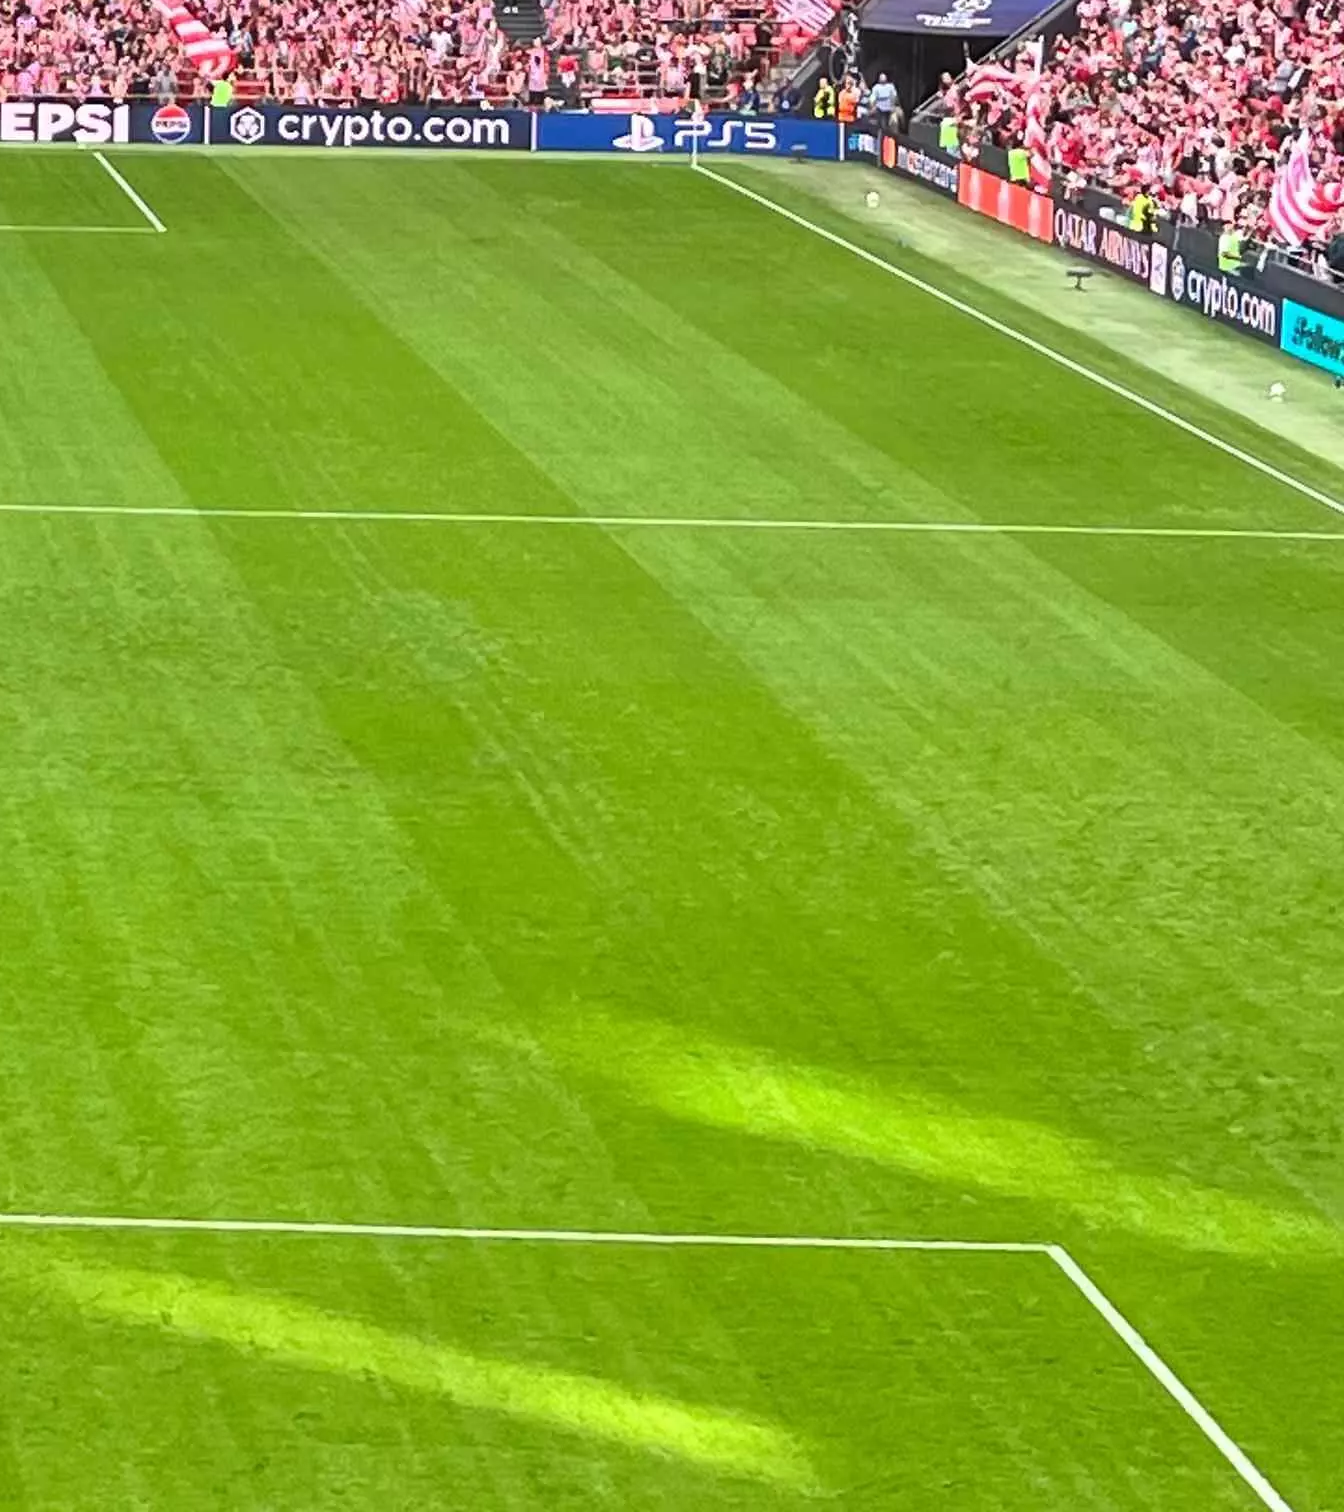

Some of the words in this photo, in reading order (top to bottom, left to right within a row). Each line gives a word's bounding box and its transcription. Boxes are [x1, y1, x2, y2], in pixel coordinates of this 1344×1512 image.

[278, 110, 510, 146] crypto.com
[673, 120, 777, 150] PS5
[1054, 208, 1097, 256] QATAR
[1187, 269, 1276, 337] crypto.com
